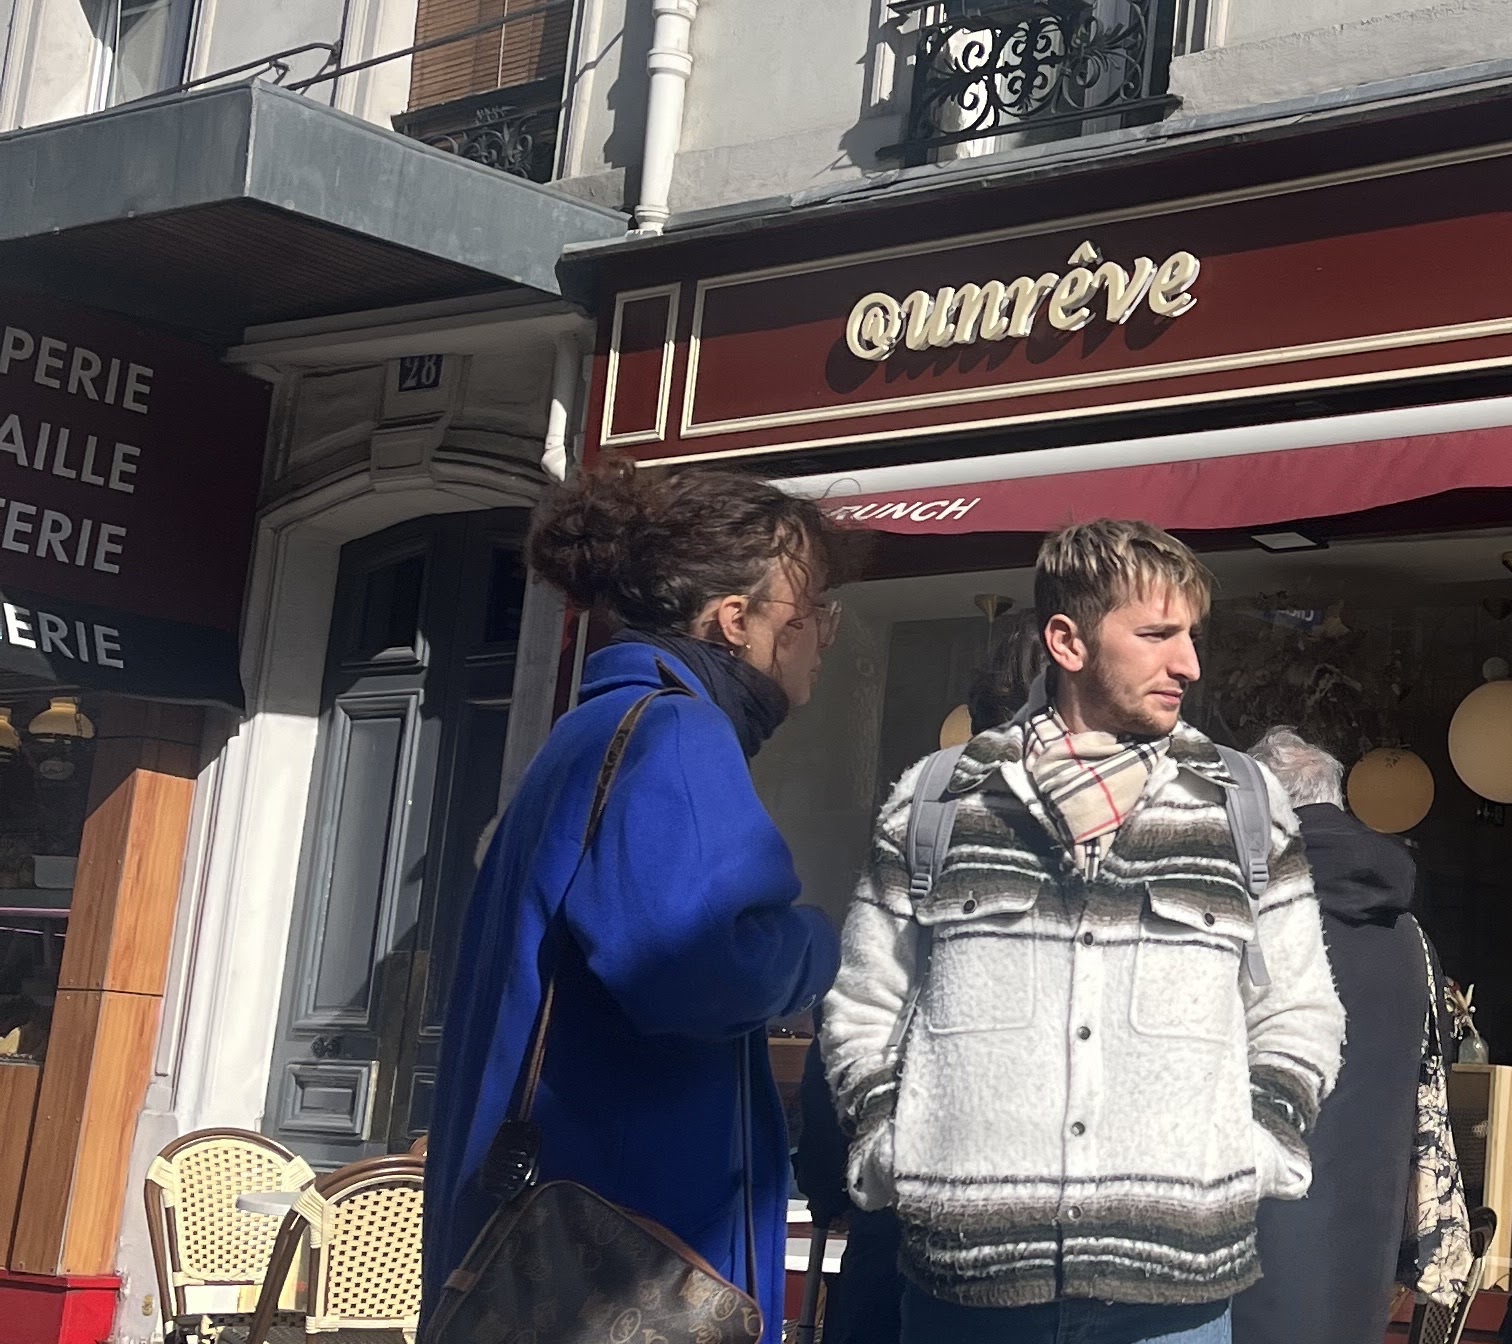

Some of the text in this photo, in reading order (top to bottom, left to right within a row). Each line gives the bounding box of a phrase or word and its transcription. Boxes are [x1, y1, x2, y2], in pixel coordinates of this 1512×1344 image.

[402, 356, 437, 388] 28
[827, 497, 981, 522] RUNCH
[0, 602, 125, 669] ERIE
